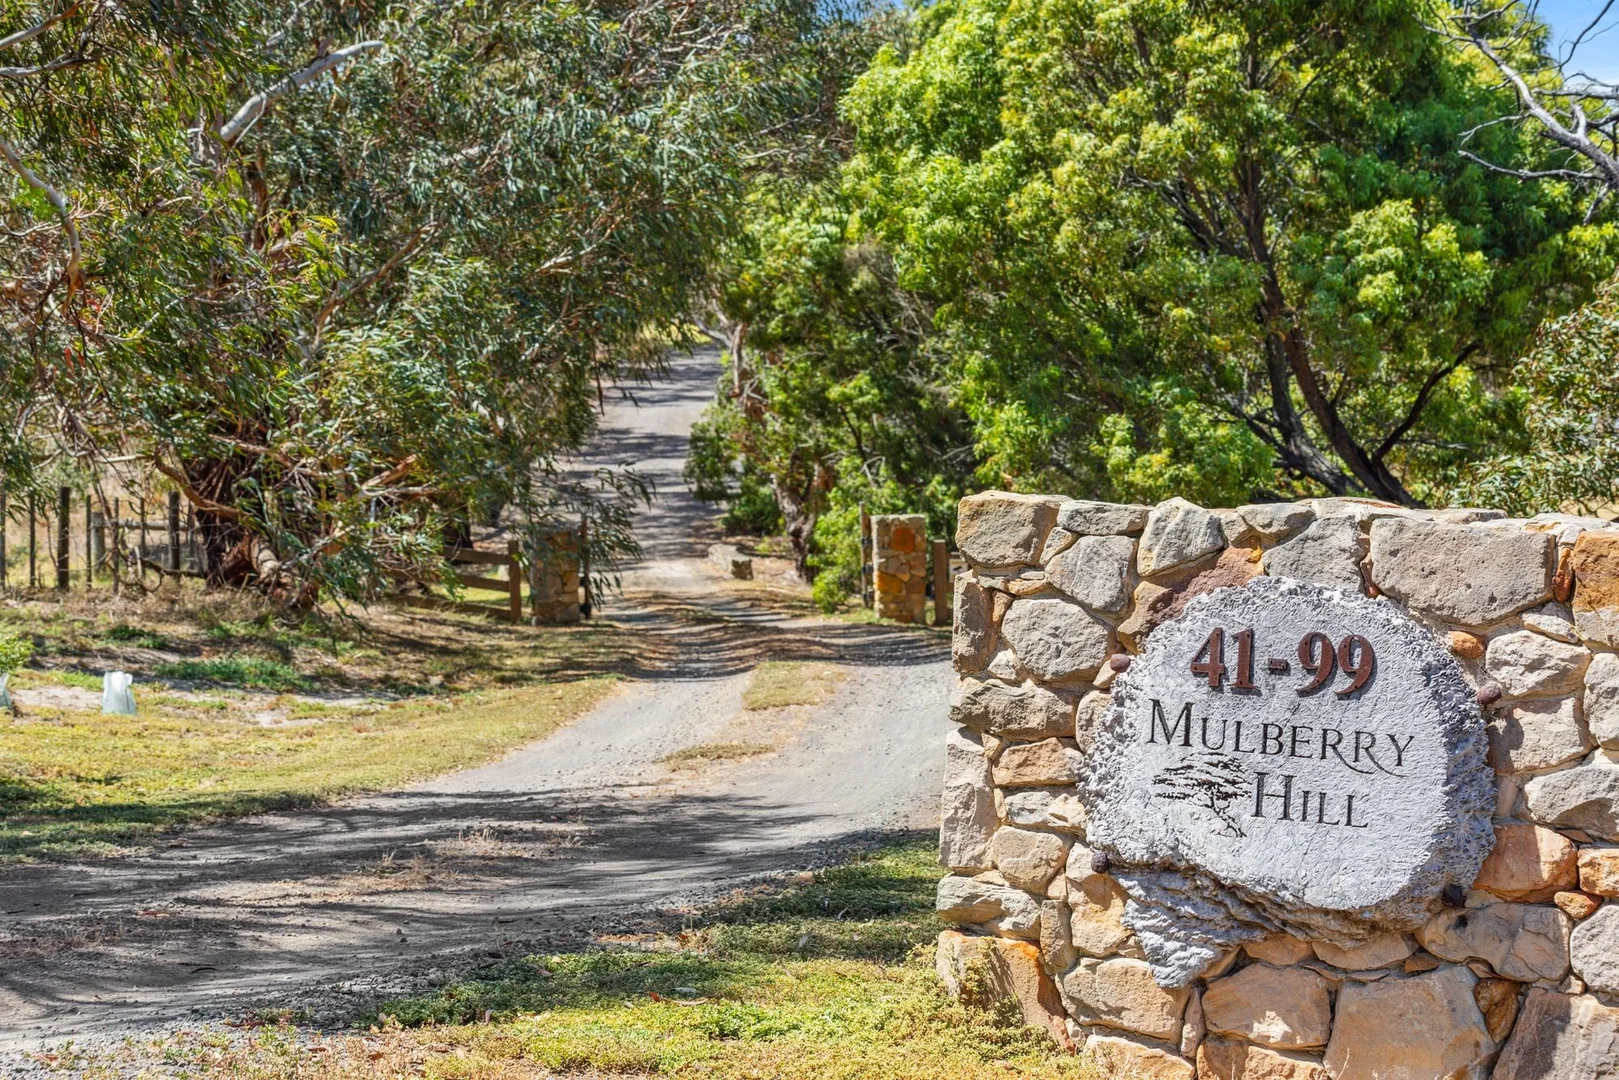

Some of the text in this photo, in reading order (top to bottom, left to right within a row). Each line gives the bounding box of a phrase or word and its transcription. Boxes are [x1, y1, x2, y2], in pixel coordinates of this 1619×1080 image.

[1190, 627, 1376, 695] 41-99
[1147, 699, 1414, 777] MULBERRY
[1251, 771, 1369, 828] HILL
